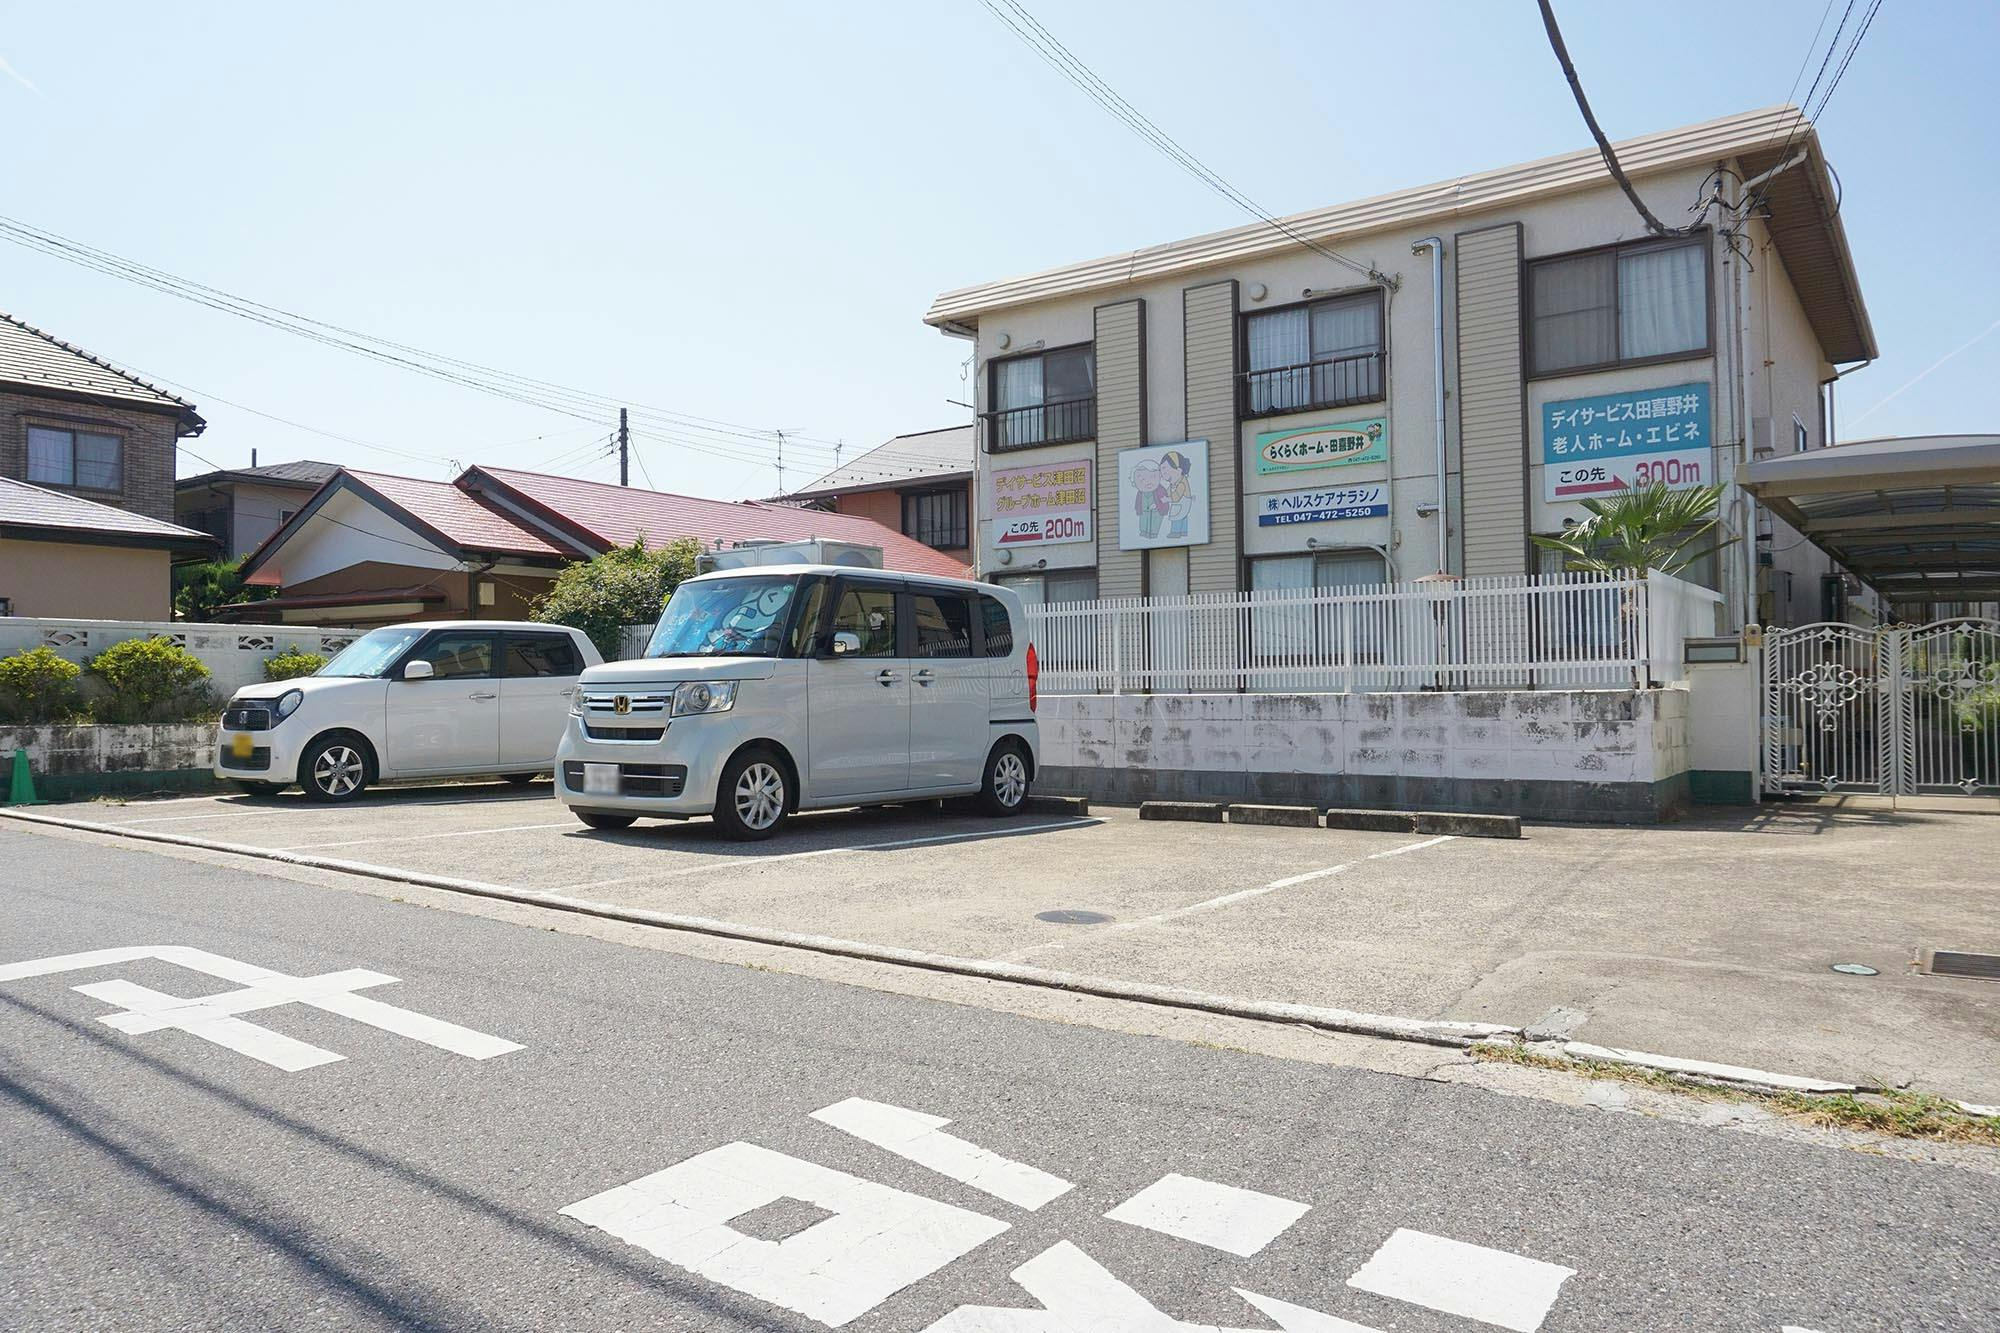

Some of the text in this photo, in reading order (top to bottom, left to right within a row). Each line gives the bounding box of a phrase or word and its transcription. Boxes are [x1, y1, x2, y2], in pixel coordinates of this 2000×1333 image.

[1551, 393, 1699, 429] デイサービス田喜野井
[1552, 421, 1700, 454] 老人ホーム・エビネ
[995, 467, 1086, 493] デイサービス津田沼
[1560, 458, 1700, 488] この先 300m
[996, 487, 1086, 512] グループホーム津田沼
[1011, 517, 1085, 540] この先 200m
[1275, 507, 1371, 524] TEL 047-472-5250
